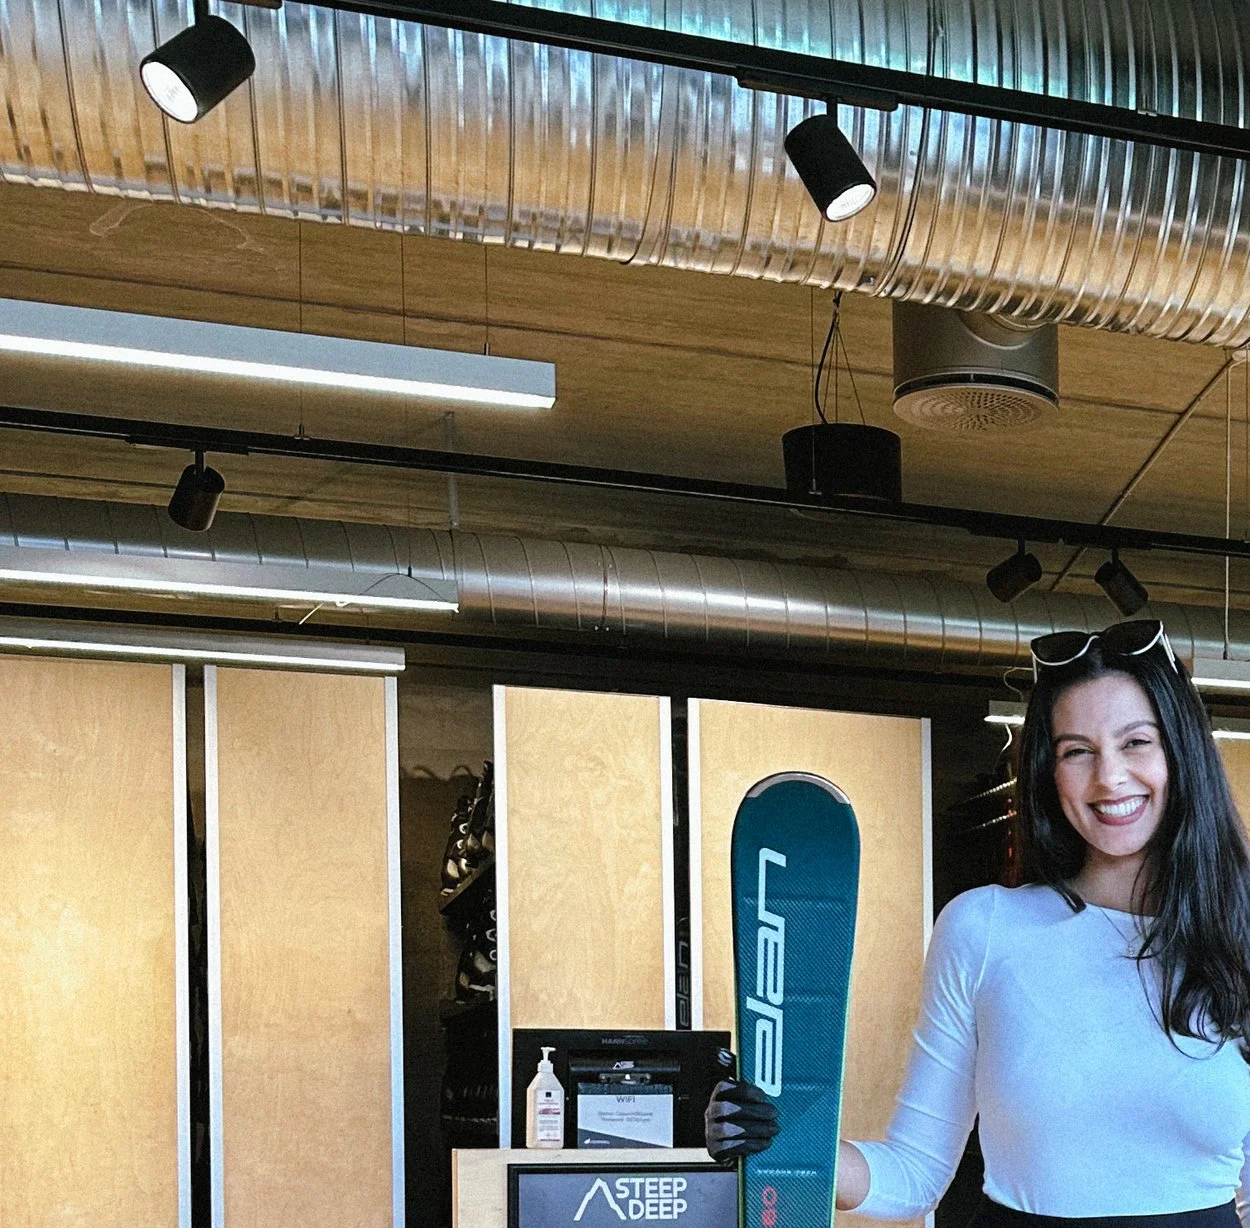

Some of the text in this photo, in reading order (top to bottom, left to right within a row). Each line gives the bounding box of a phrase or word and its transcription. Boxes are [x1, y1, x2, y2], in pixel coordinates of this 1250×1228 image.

[746, 847, 787, 1098] elan
[615, 1177, 688, 1199] STEEP
[628, 1199, 688, 1220] DEEP
